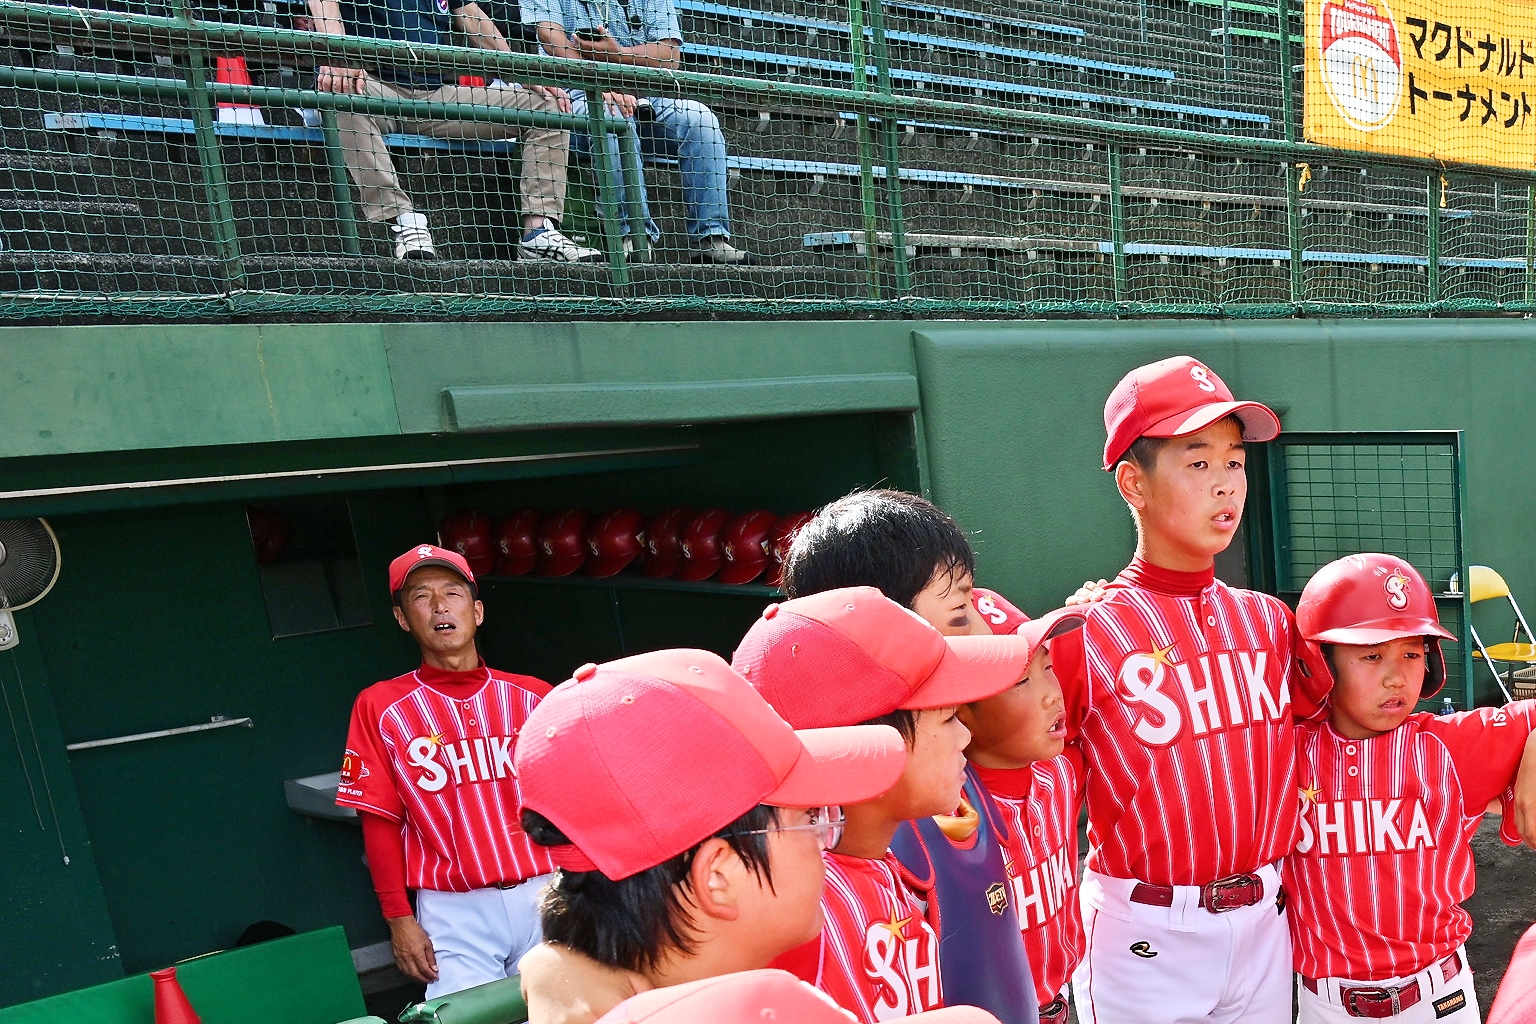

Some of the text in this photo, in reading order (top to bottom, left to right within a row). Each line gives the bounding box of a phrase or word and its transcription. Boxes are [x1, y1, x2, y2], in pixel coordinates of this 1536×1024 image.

[1330, 7, 1390, 53] TOURNAMENT
[1406, 17, 1535, 79] マクドナルド
[1408, 72, 1532, 130] トーナメント
